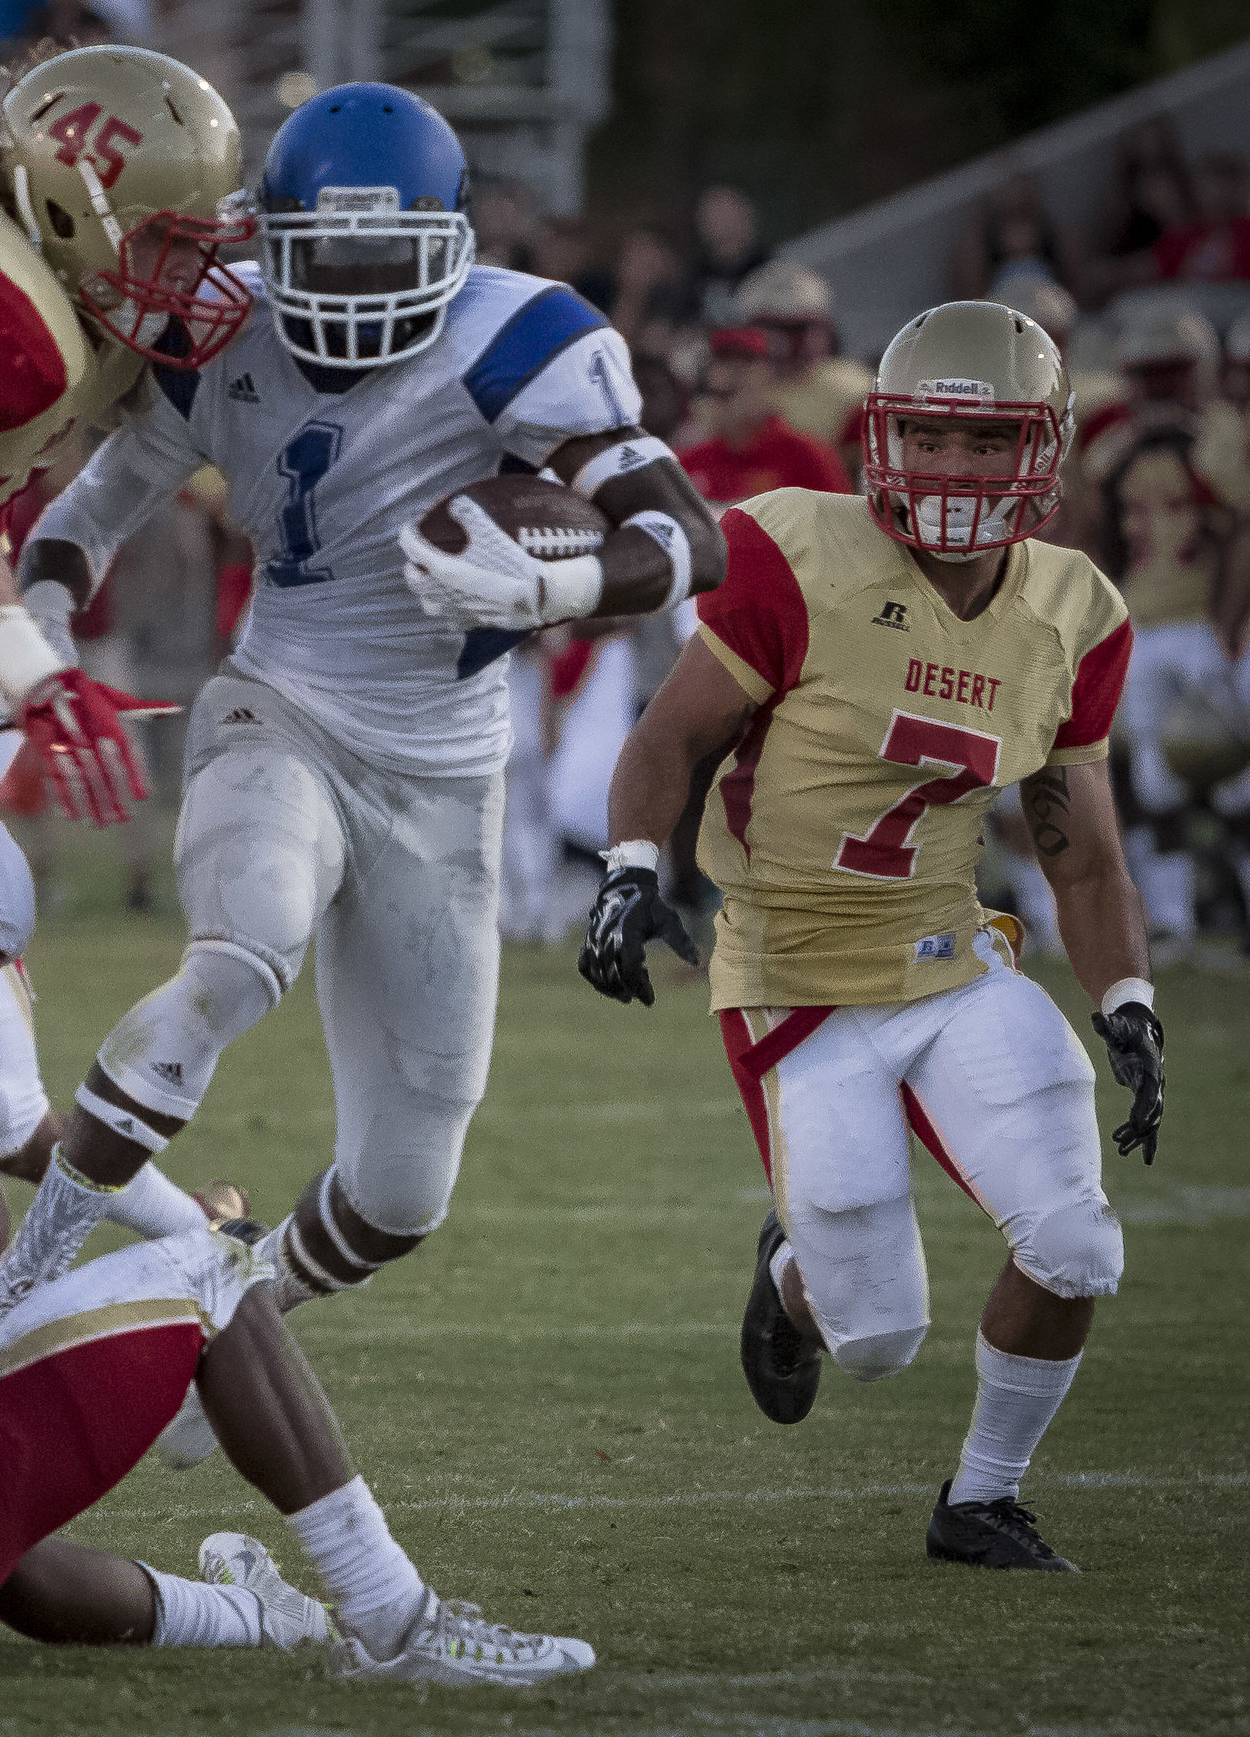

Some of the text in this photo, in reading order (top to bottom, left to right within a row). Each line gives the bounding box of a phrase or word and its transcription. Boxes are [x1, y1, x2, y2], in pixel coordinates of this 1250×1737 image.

[49, 102, 143, 189] 45
[936, 381, 979, 395] Riddell
[265, 420, 345, 588] 1
[880, 601, 907, 623] R
[904, 658, 1002, 712] DESERT
[831, 708, 1004, 881] 7
